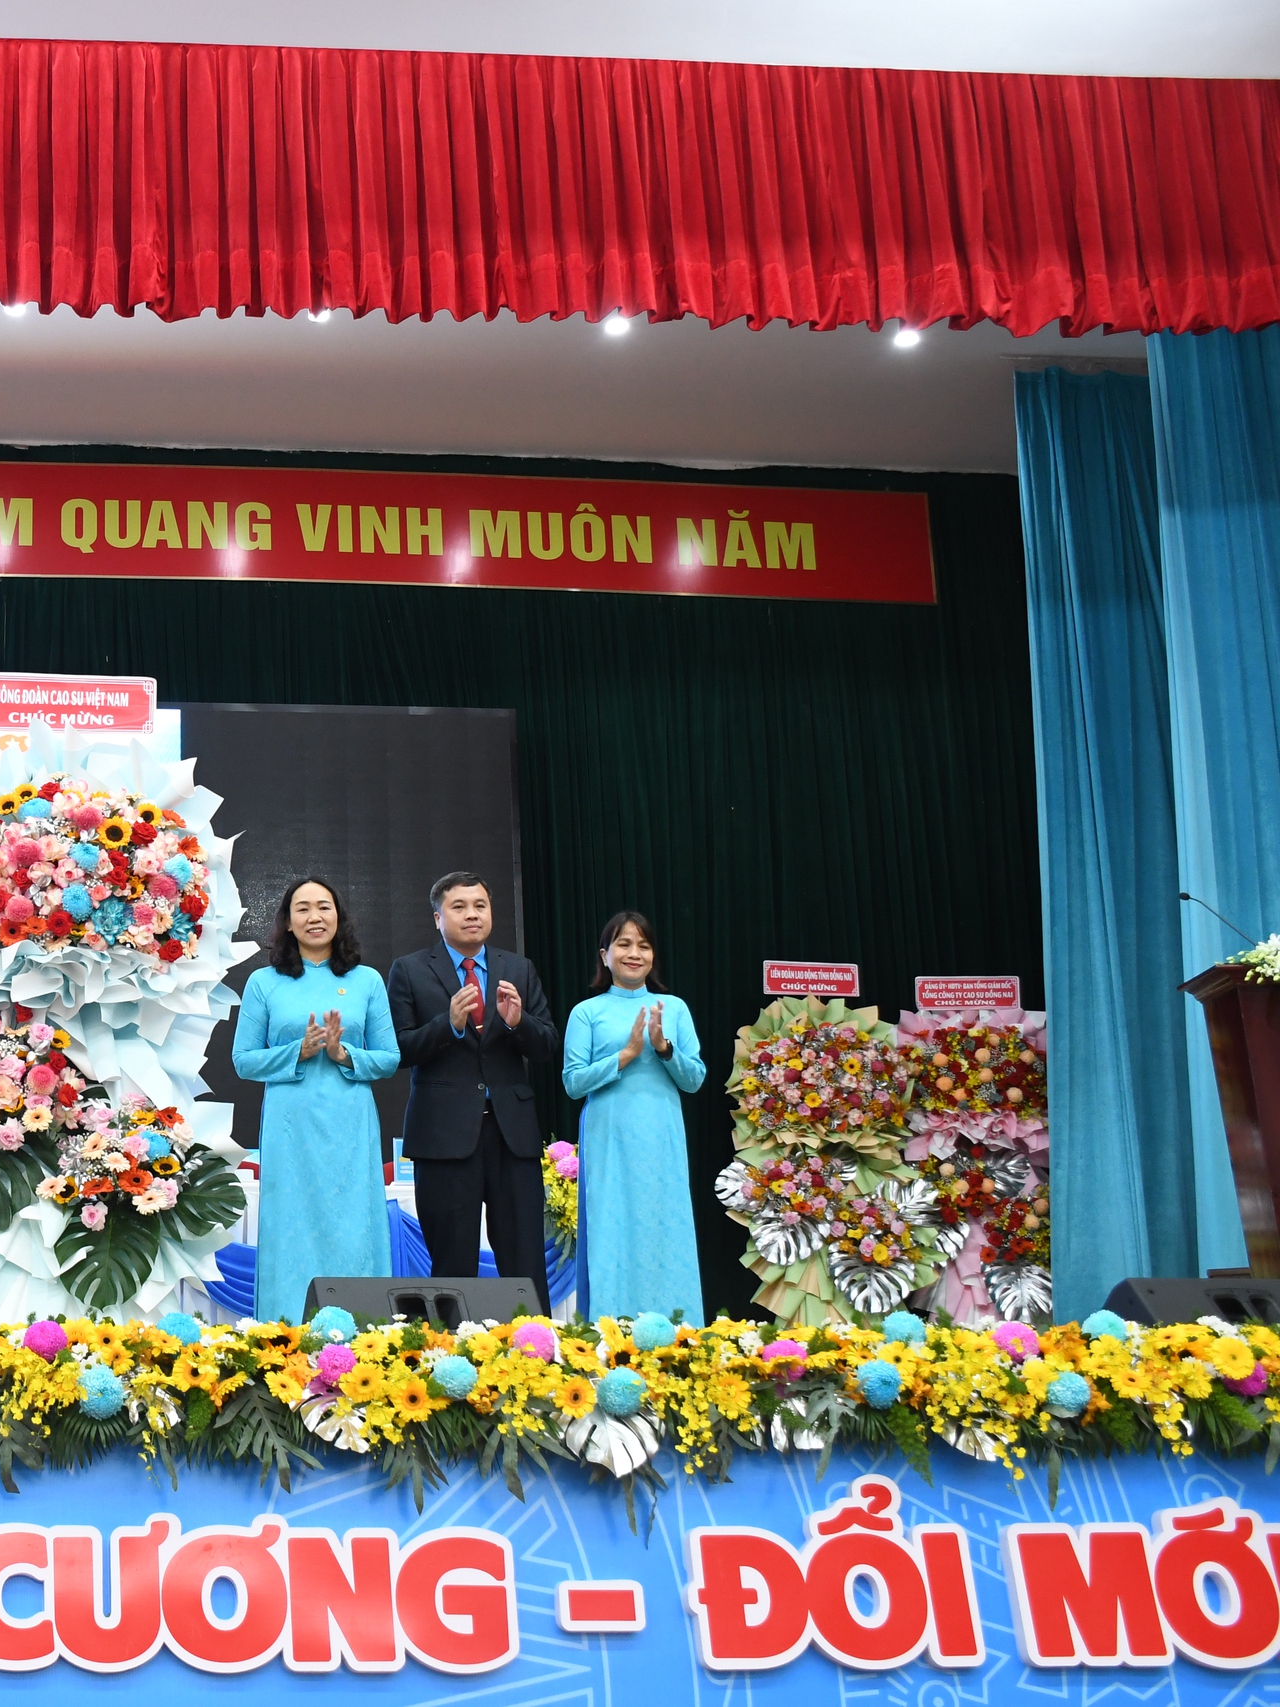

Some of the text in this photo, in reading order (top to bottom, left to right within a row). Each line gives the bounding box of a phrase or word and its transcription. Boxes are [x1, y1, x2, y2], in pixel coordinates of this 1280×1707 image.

[59, 497, 273, 554] QUANG
[294, 502, 445, 557] VINH
[469, 501, 654, 565] MUÔN
[674, 508, 818, 572] NĂM
[22, 685, 49, 705] ĐOÀN
[50, 690, 70, 706] CAO
[71, 690, 84, 706] SU
[85, 687, 106, 710] VIỆT
[107, 692, 129, 707] NAM
[7, 709, 114, 726] CHÚC MỪNG
[780, 982, 837, 991] CHÚC MỪNG
[938, 990, 954, 999] CÔNG
[695, 1479, 982, 1662] ĐỔI
